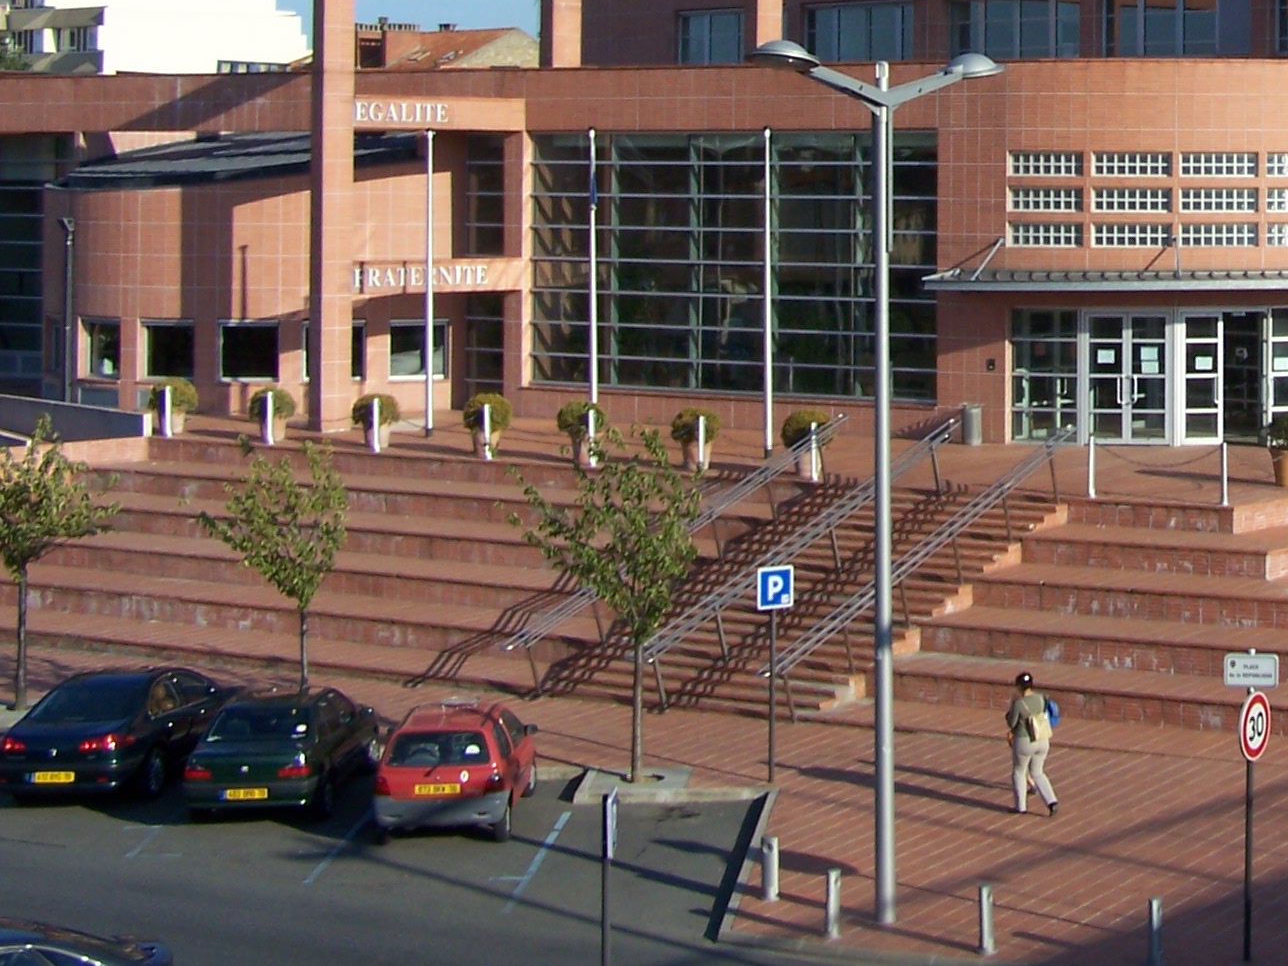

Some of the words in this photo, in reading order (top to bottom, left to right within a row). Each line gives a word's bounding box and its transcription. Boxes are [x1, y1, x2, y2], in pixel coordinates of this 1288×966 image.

[355, 100, 450, 123] EGALITE
[767, 575, 784, 602] P
[1249, 712, 1264, 741] 30
